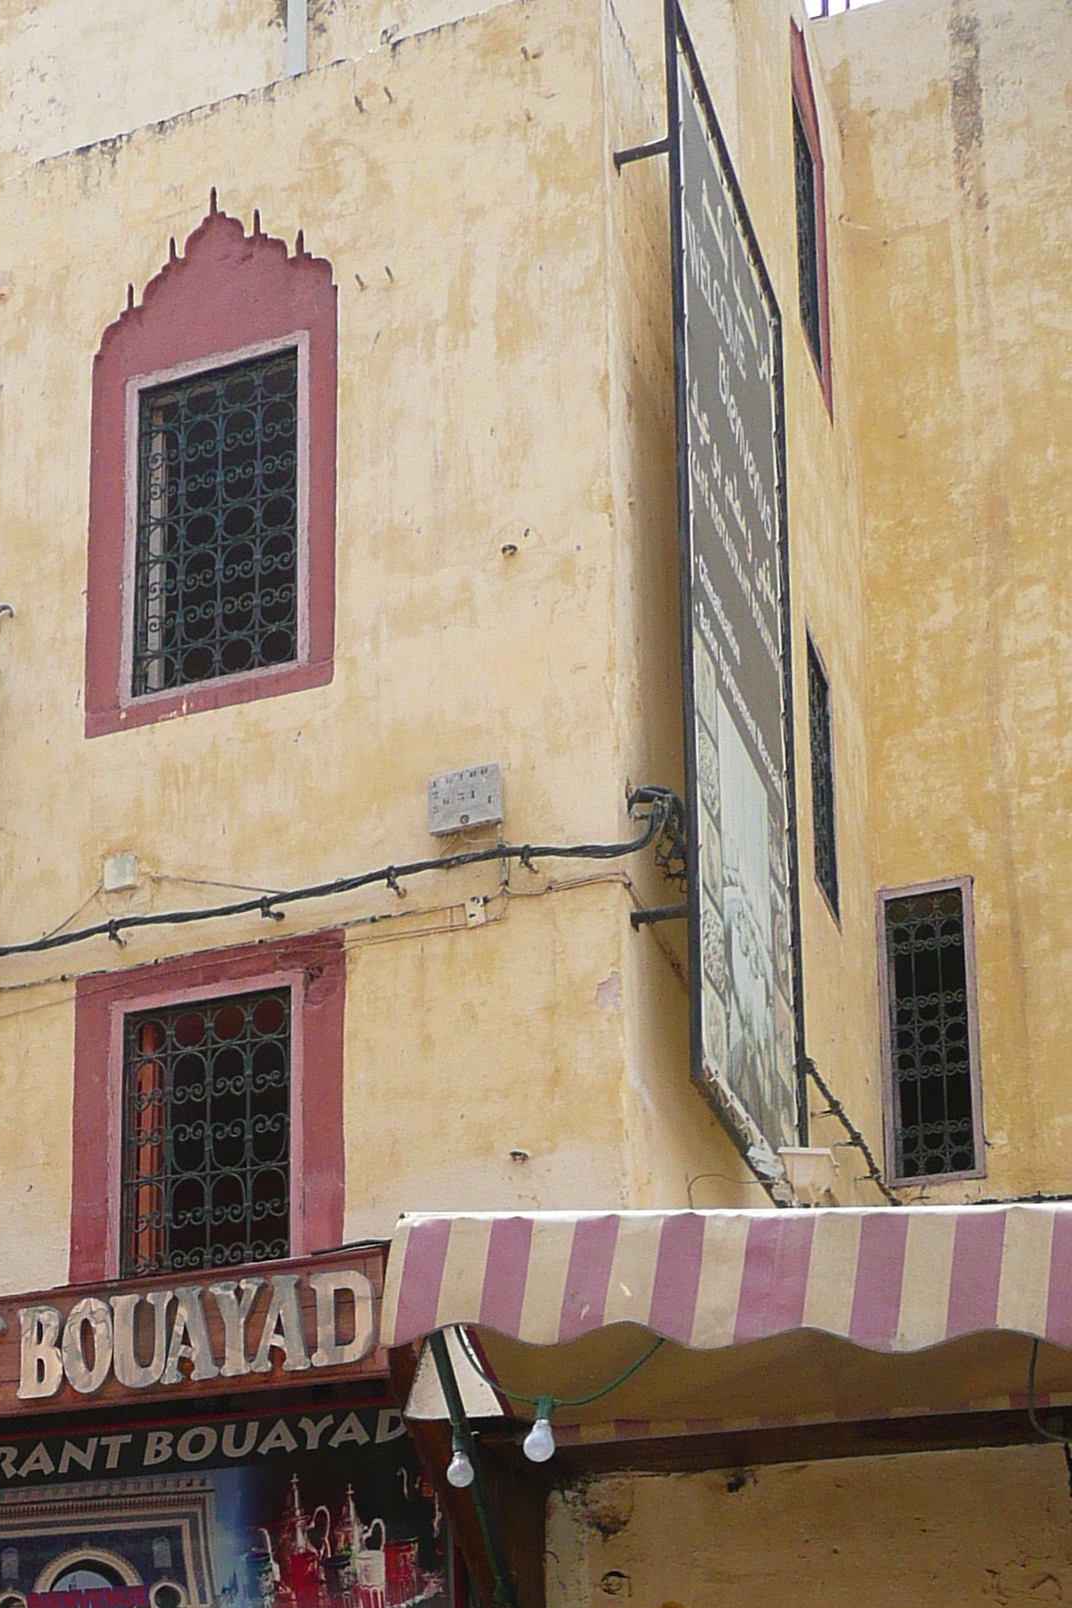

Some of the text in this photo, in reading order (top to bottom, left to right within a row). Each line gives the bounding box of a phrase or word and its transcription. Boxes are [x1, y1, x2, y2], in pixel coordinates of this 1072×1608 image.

[685, 208, 746, 381] WELCOME
[16, 1269, 376, 1400] BOUAYAD
[142, 1408, 407, 1467] BOUAYAD
